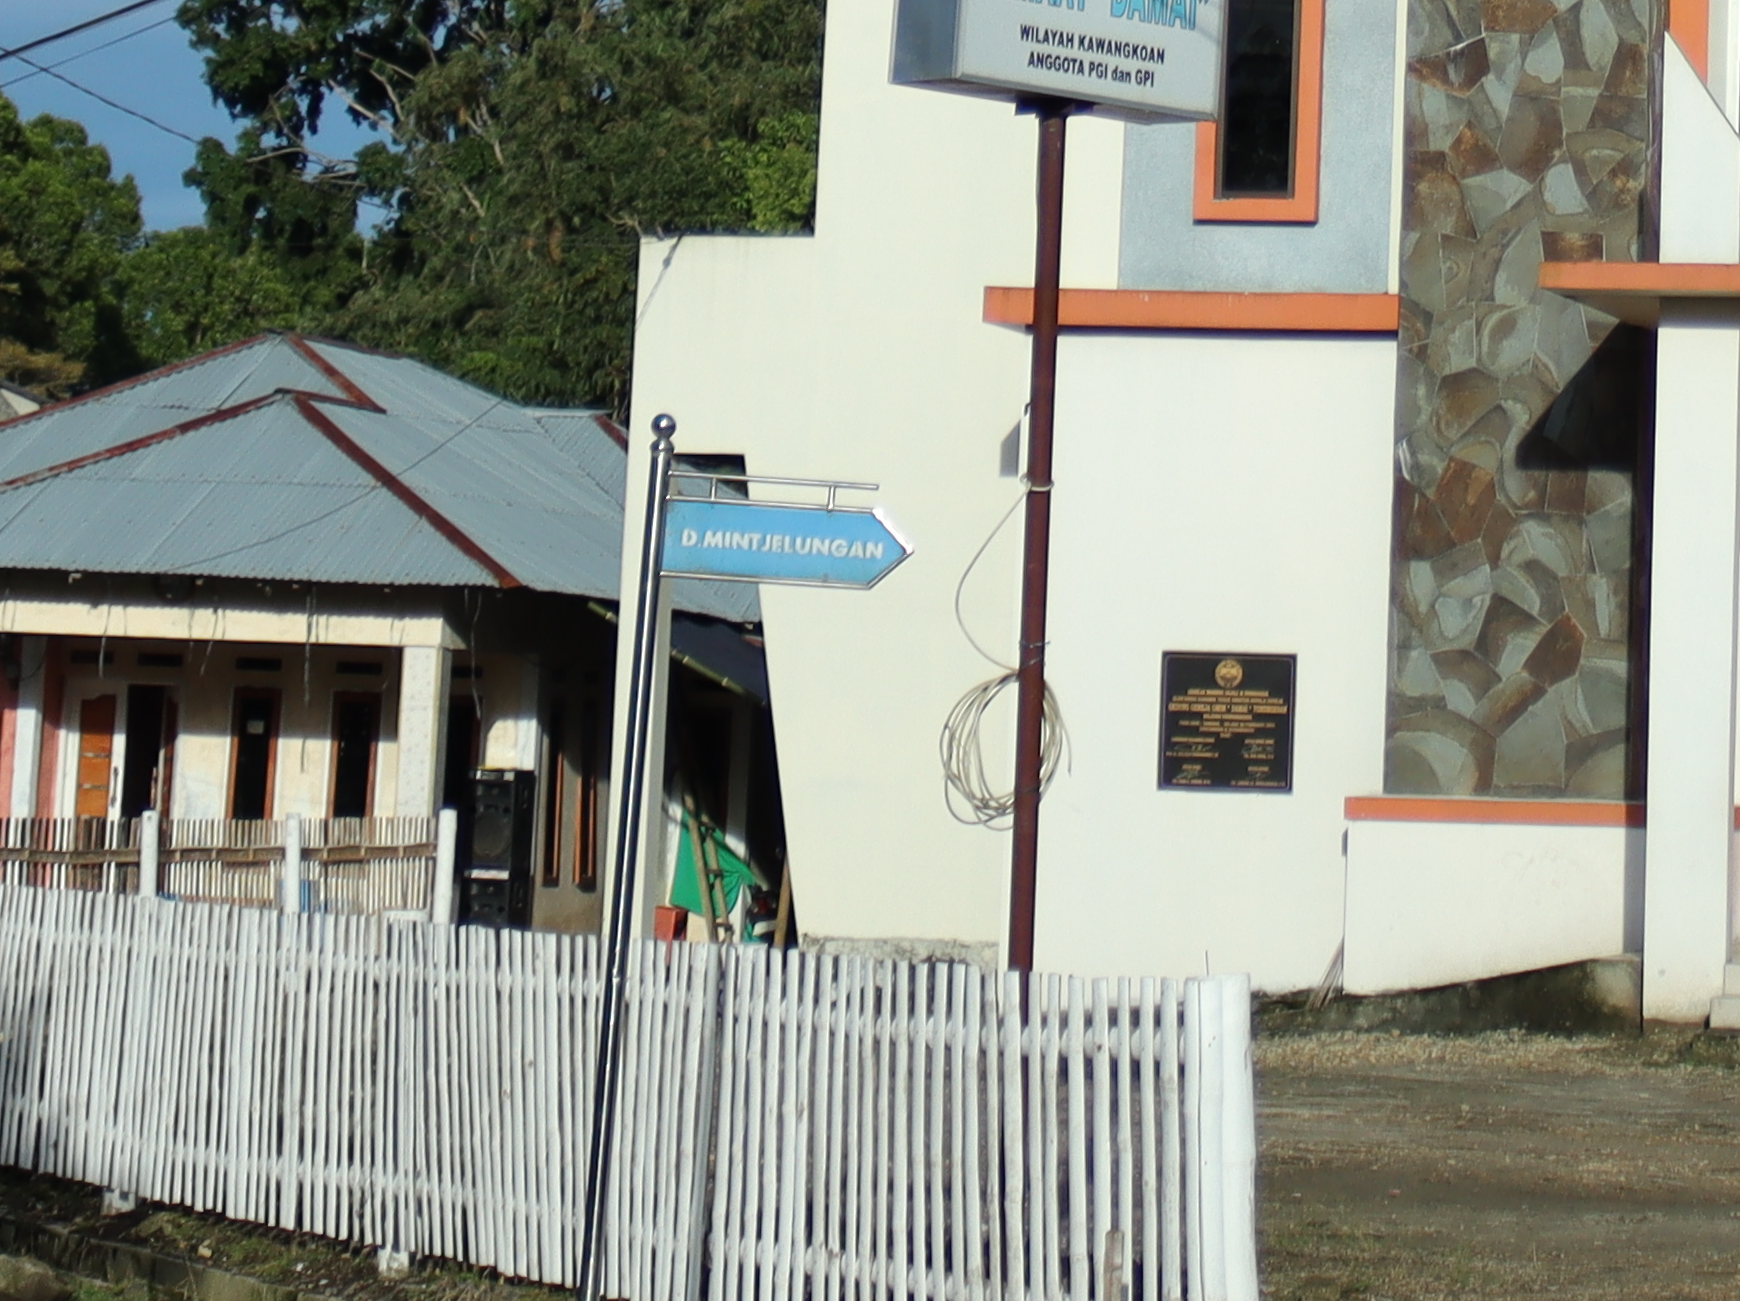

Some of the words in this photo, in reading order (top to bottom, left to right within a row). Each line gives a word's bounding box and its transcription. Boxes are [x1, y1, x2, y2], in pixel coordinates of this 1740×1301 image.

[1020, 23, 1074, 49] WILAYAH
[1078, 34, 1165, 65] KAWANGKOAN
[1027, 51, 1084, 76] ANGGOTA
[1088, 61, 1108, 80] PGI
[1111, 66, 1132, 85] dan
[1135, 69, 1155, 87] GPI
